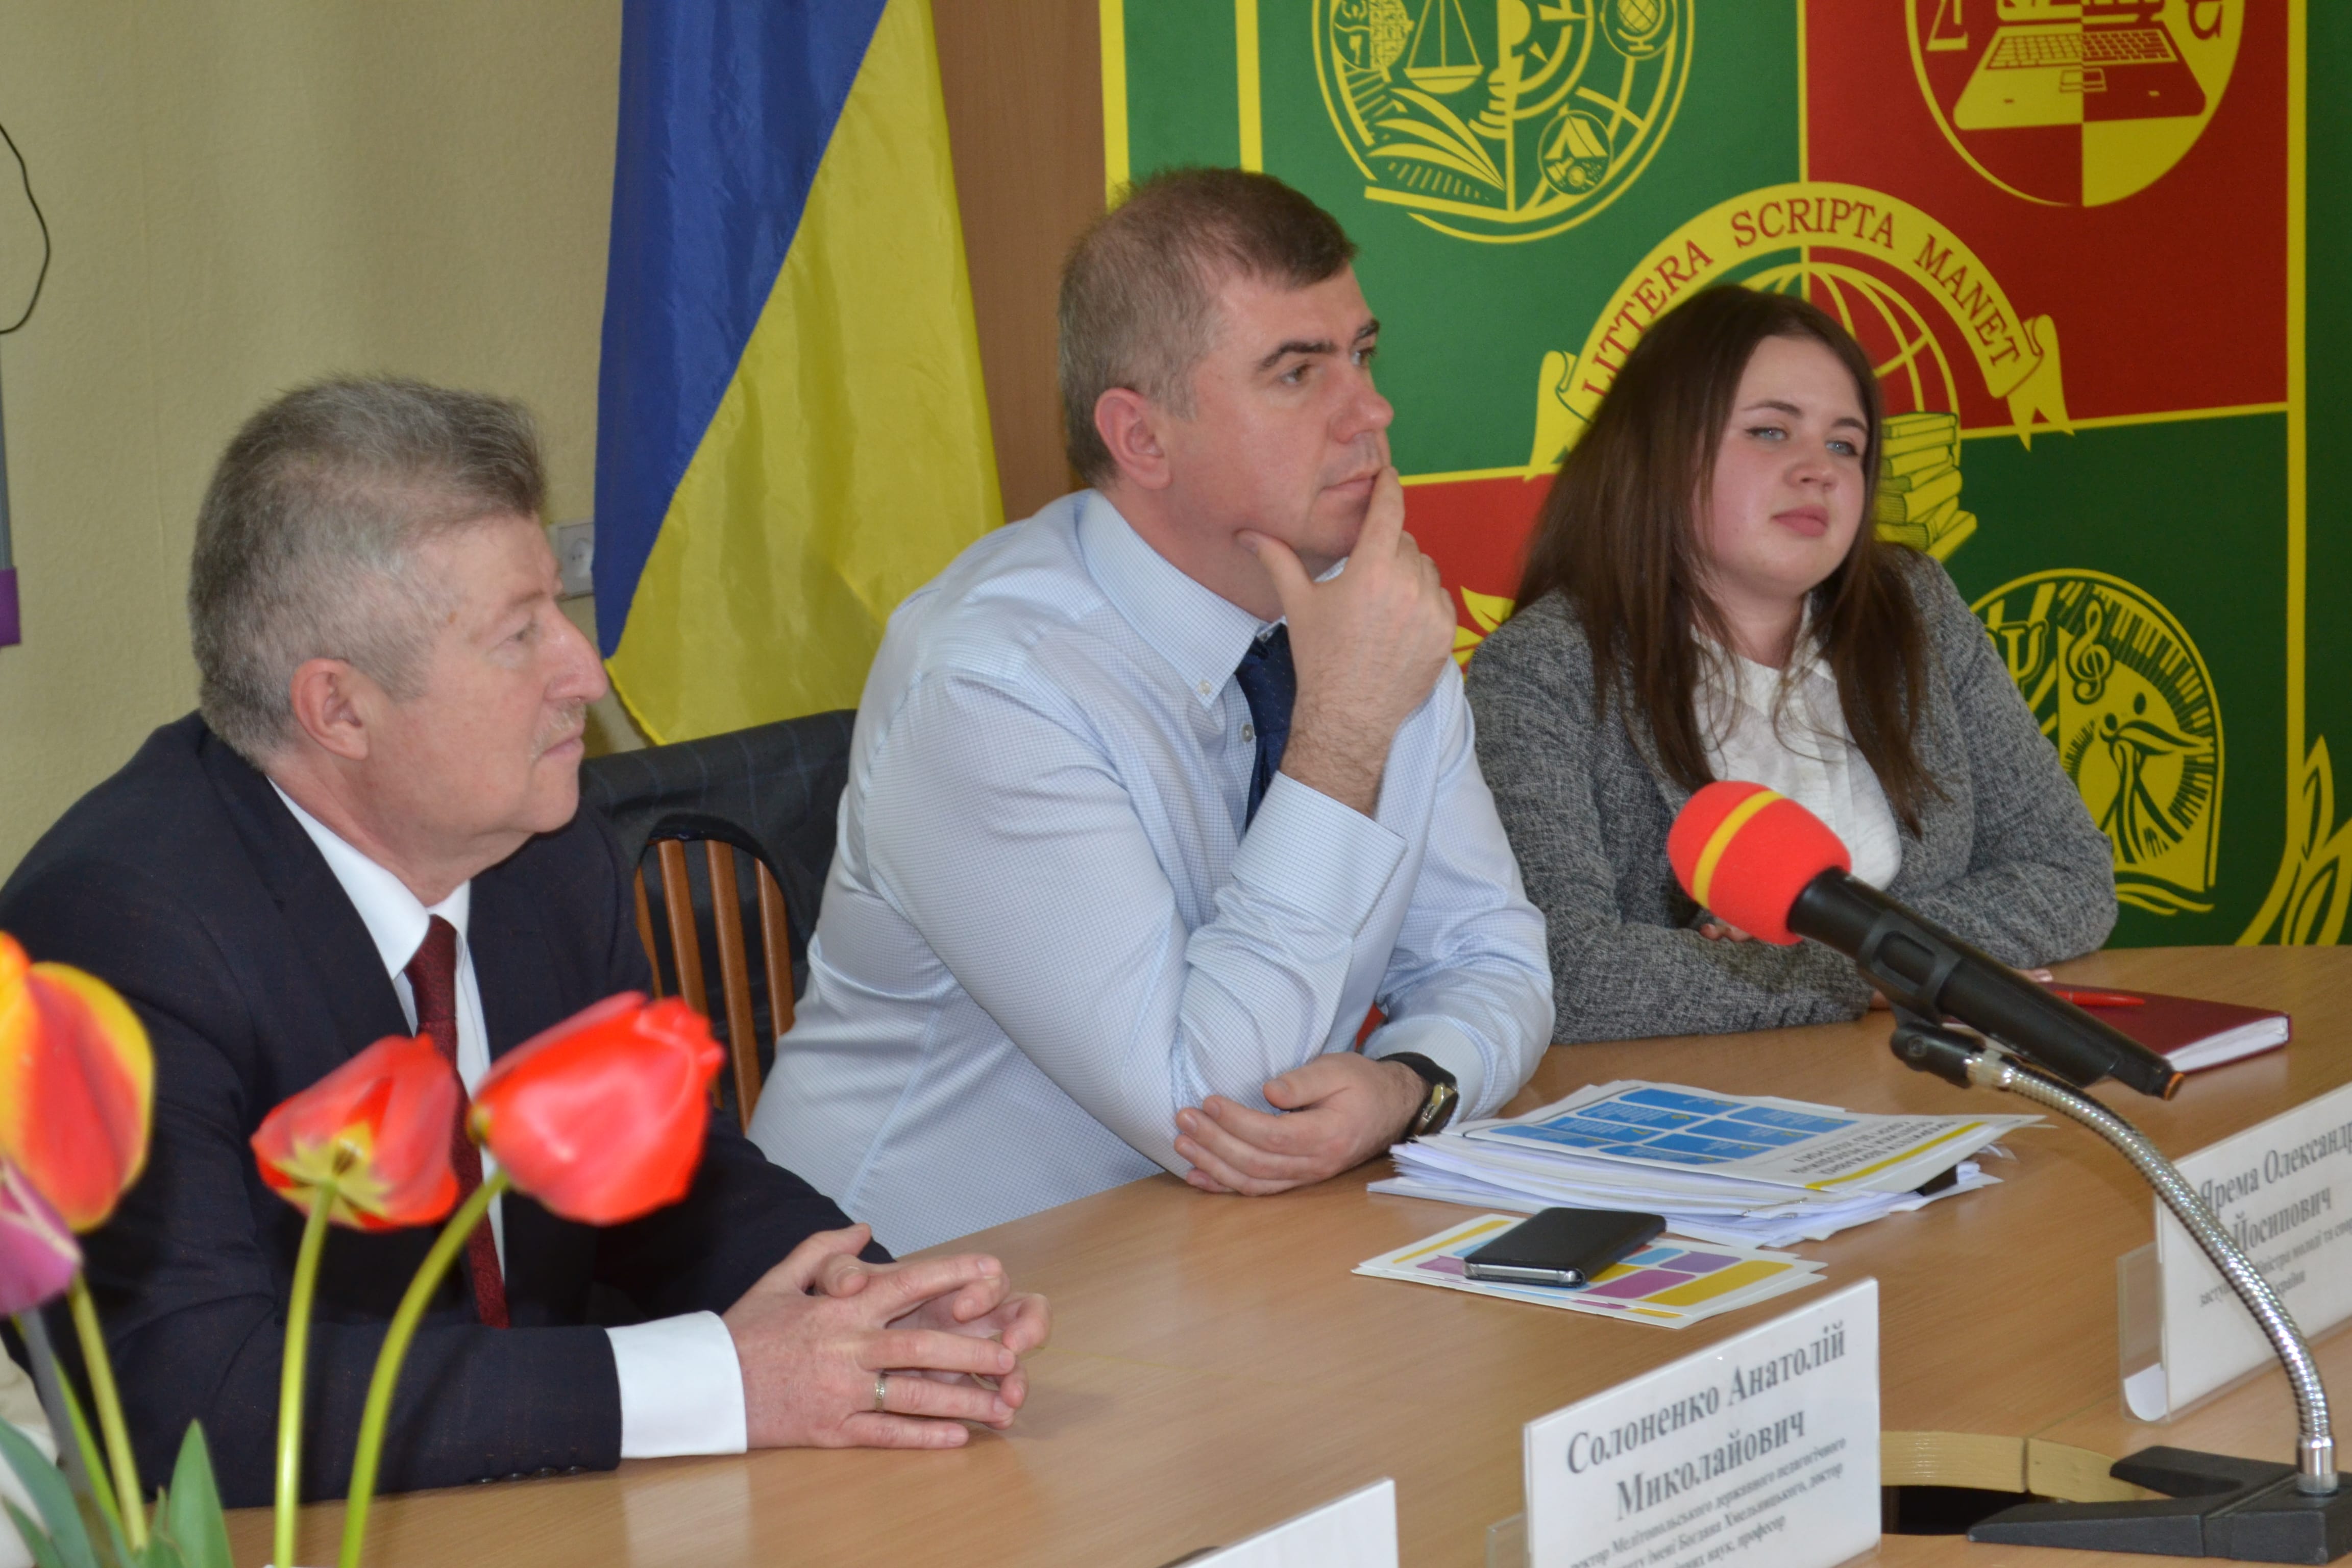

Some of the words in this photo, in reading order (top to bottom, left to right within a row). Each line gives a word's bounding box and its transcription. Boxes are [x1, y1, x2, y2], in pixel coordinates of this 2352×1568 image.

[1582, 239, 1713, 397] LITTERA
[1731, 198, 1894, 249] SCRIPTA
[1914, 233, 2020, 366] MANET
[2200, 1168, 2259, 1218] Ярема
[2233, 1187, 2331, 1251] Йосипович
[1566, 1386, 1719, 1474] Солоненко
[1727, 1320, 1846, 1406] Анатолій
[1616, 1411, 1805, 1522] Миколайович
